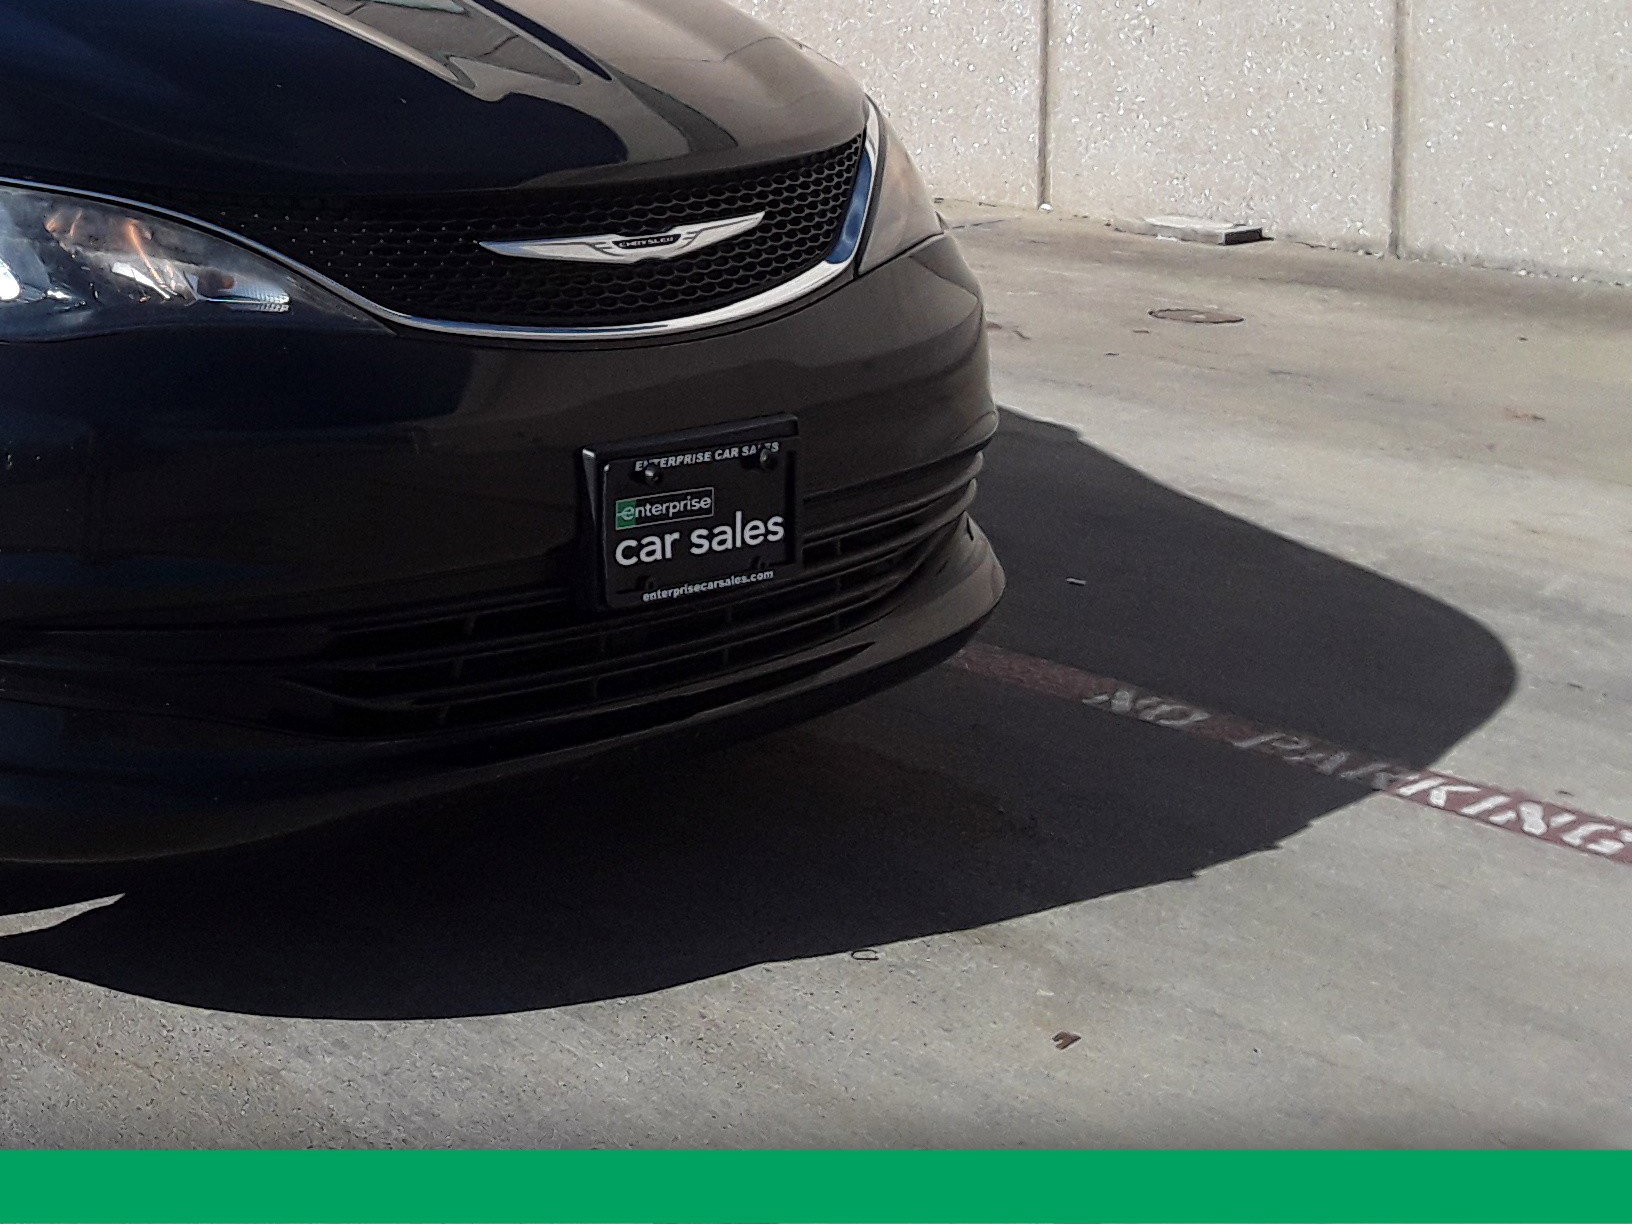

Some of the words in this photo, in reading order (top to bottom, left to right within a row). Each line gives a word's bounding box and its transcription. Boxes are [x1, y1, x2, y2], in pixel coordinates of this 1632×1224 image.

[714, 447, 739, 461] CAR
[741, 441, 780, 457] SAES
[617, 495, 712, 522] enterprise
[615, 531, 681, 566] car
[690, 510, 785, 555] sales
[642, 569, 775, 603] enterprisecarsales.com
[1081, 688, 1212, 727] NO
[1231, 730, 1632, 856] PARKING
